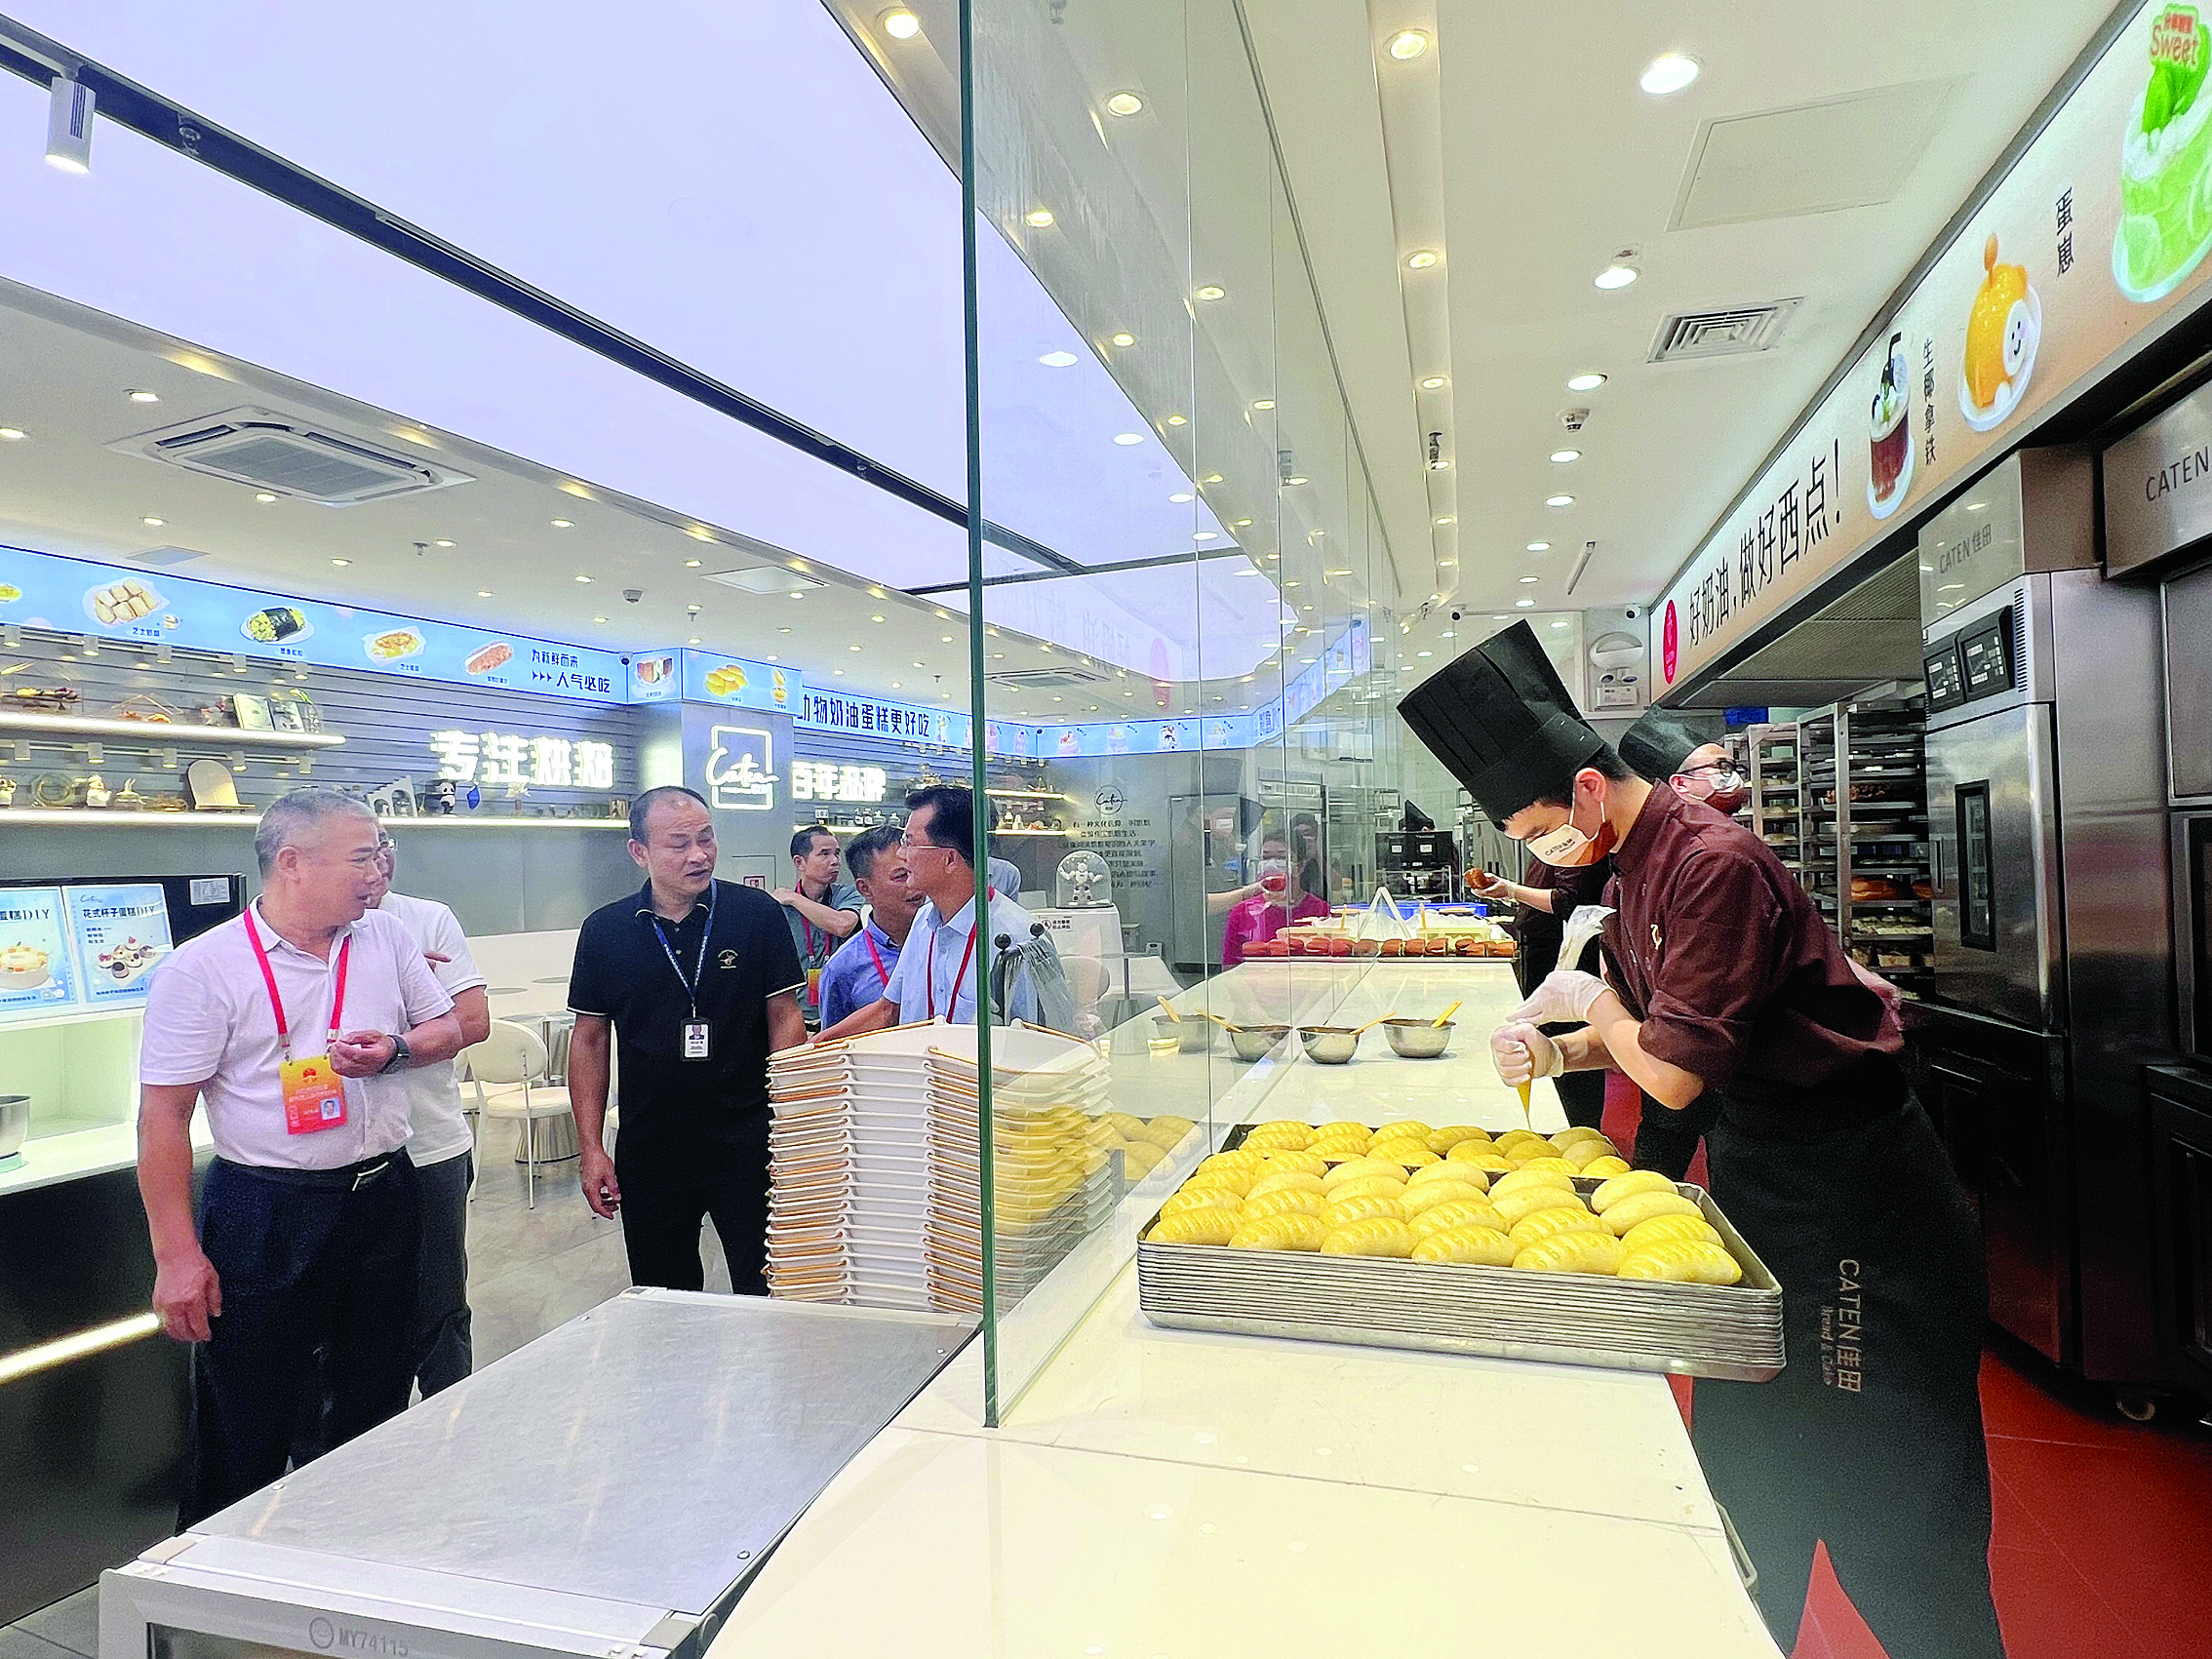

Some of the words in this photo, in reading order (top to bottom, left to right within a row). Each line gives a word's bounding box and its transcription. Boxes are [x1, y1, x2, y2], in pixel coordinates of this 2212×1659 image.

[2151, 24, 2197, 65] Sweet
[2146, 446, 2211, 501] CATEN
[532, 649, 578, 669] 为新鲜而来
[556, 672, 611, 692] 人气必吃
[430, 731, 613, 787] 专注烘焙
